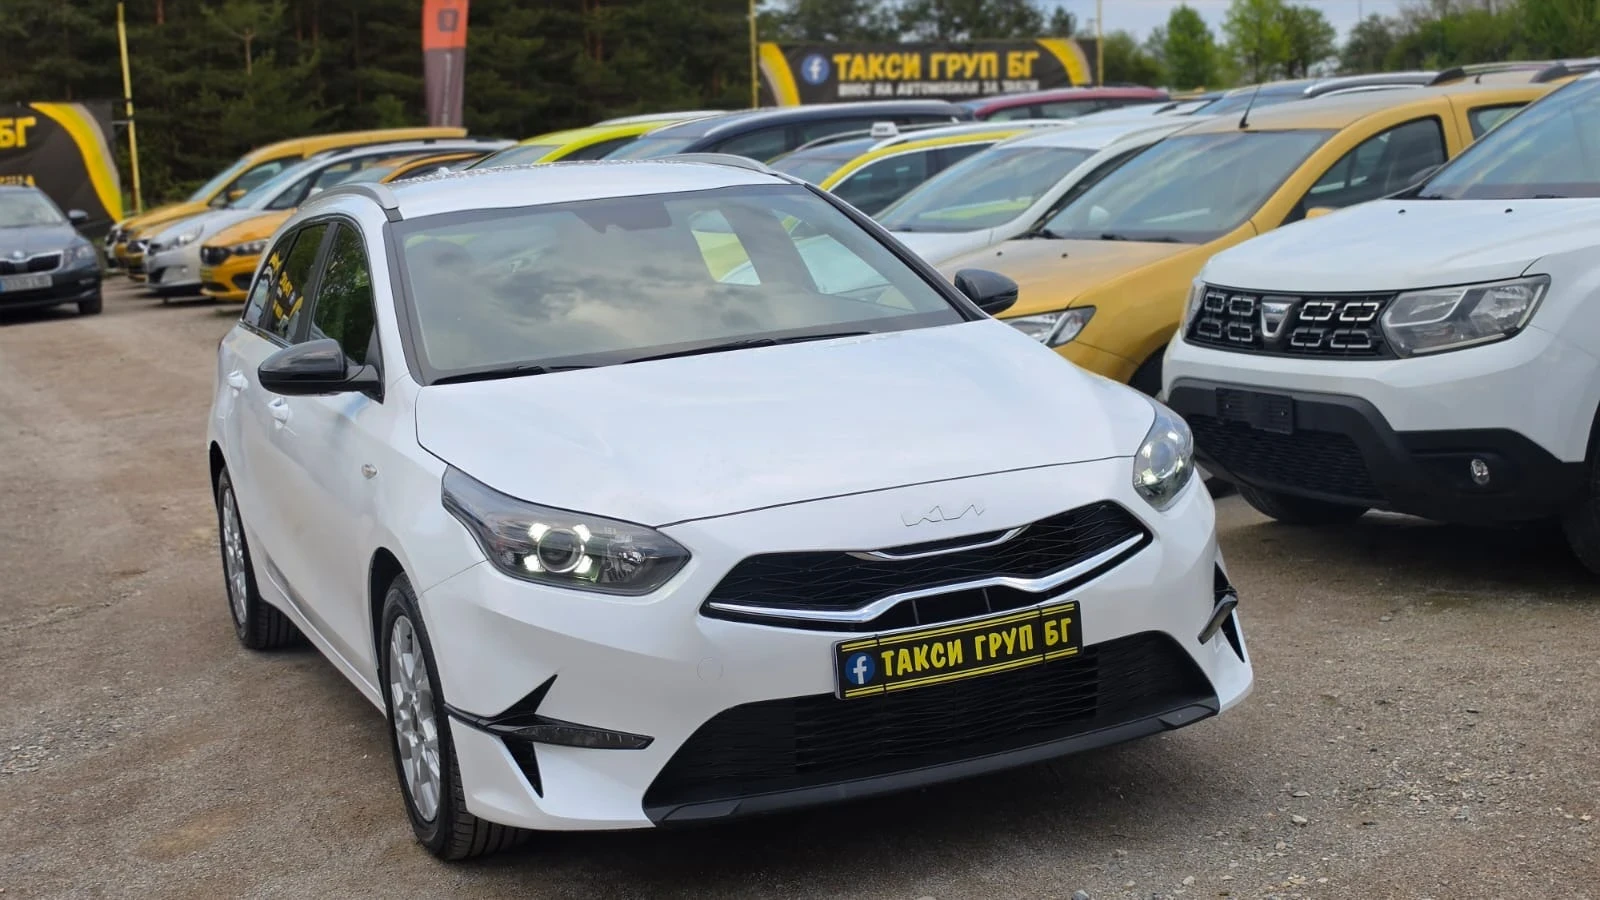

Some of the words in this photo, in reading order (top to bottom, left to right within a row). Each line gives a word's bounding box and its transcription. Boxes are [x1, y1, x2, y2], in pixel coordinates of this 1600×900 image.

[833, 52, 921, 81] ТАКСИ
[930, 52, 998, 80] ГРУП
[1007, 51, 1039, 78] БГ
[0, 116, 37, 148] БГ
[881, 638, 963, 676] ТАКСИ
[975, 624, 1033, 661] ГРУП
[1044, 617, 1072, 646] БГ
